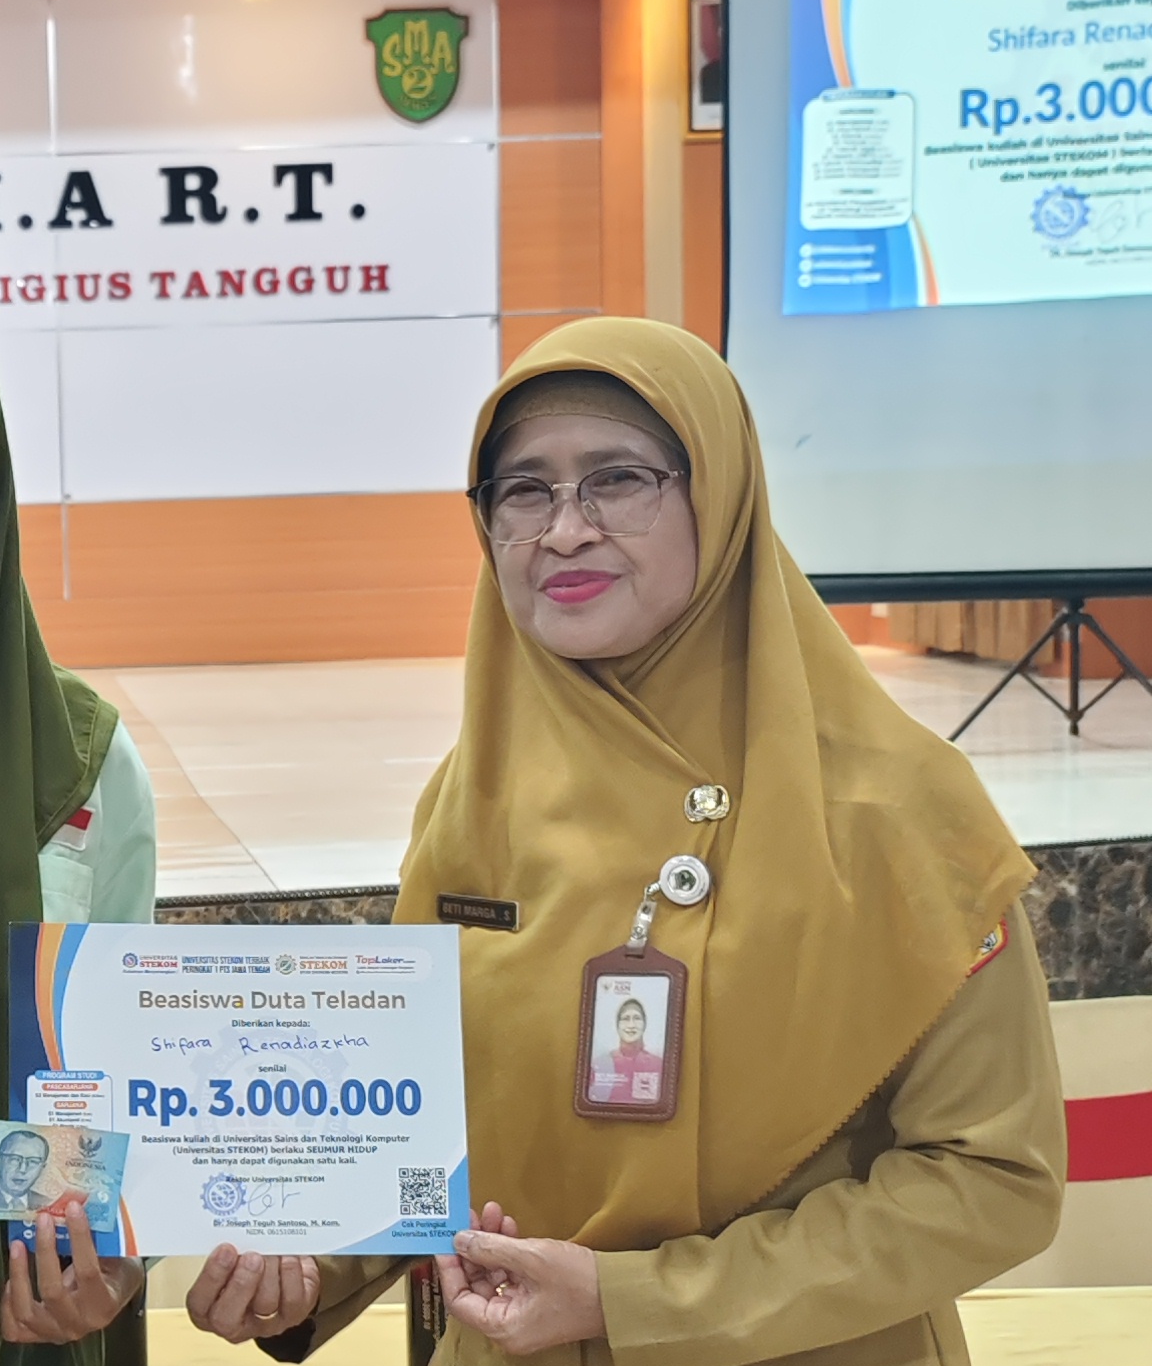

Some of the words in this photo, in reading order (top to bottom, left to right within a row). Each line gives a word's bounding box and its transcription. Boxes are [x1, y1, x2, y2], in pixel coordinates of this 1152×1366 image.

[987, 26, 1076, 52] Shifara
[381, 20, 455, 76] SMA
[159, 163, 368, 225] R.T.
[148, 264, 392, 300] TANGGUH
[299, 960, 348, 970] STEKOM
[139, 989, 244, 1009] Beasiswa
[251, 990, 306, 1009] Duta
[311, 989, 406, 1009] Teladan
[231, 1019, 274, 1028] Diberikan
[275, 1019, 311, 1030] kepada:
[151, 1036, 212, 1056] Shifara
[258, 1064, 287, 1073] senilai
[128, 1079, 198, 1127] Rp.
[208, 1078, 422, 1118] 3.000.000
[141, 1135, 182, 1143] Beasiswa
[183, 1134, 210, 1143] kuliah
[212, 1134, 221, 1143] di
[223, 1134, 272, 1143] Universitas
[274, 1134, 299, 1143] Sains
[300, 1134, 318, 1143] dan
[319, 1134, 364, 1145] Teknologi
[365, 1135, 410, 1145] Komputer
[172, 1146, 225, 1155] (Universitas
[227, 1146, 268, 1155] STEKOM)
[270, 1146, 305, 1154] berlaku
[306, 1146, 346, 1154] SEUMUR
[347, 1146, 378, 1154] HIDUP
[192, 1157, 209, 1165] dan
[211, 1157, 238, 1166] hanya
[239, 1157, 266, 1166] dapat
[267, 1157, 315, 1166] digunakan
[316, 1157, 337, 1165] satu
[338, 1157, 358, 1165] kali.
[252, 1220, 276, 1228] Teguh
